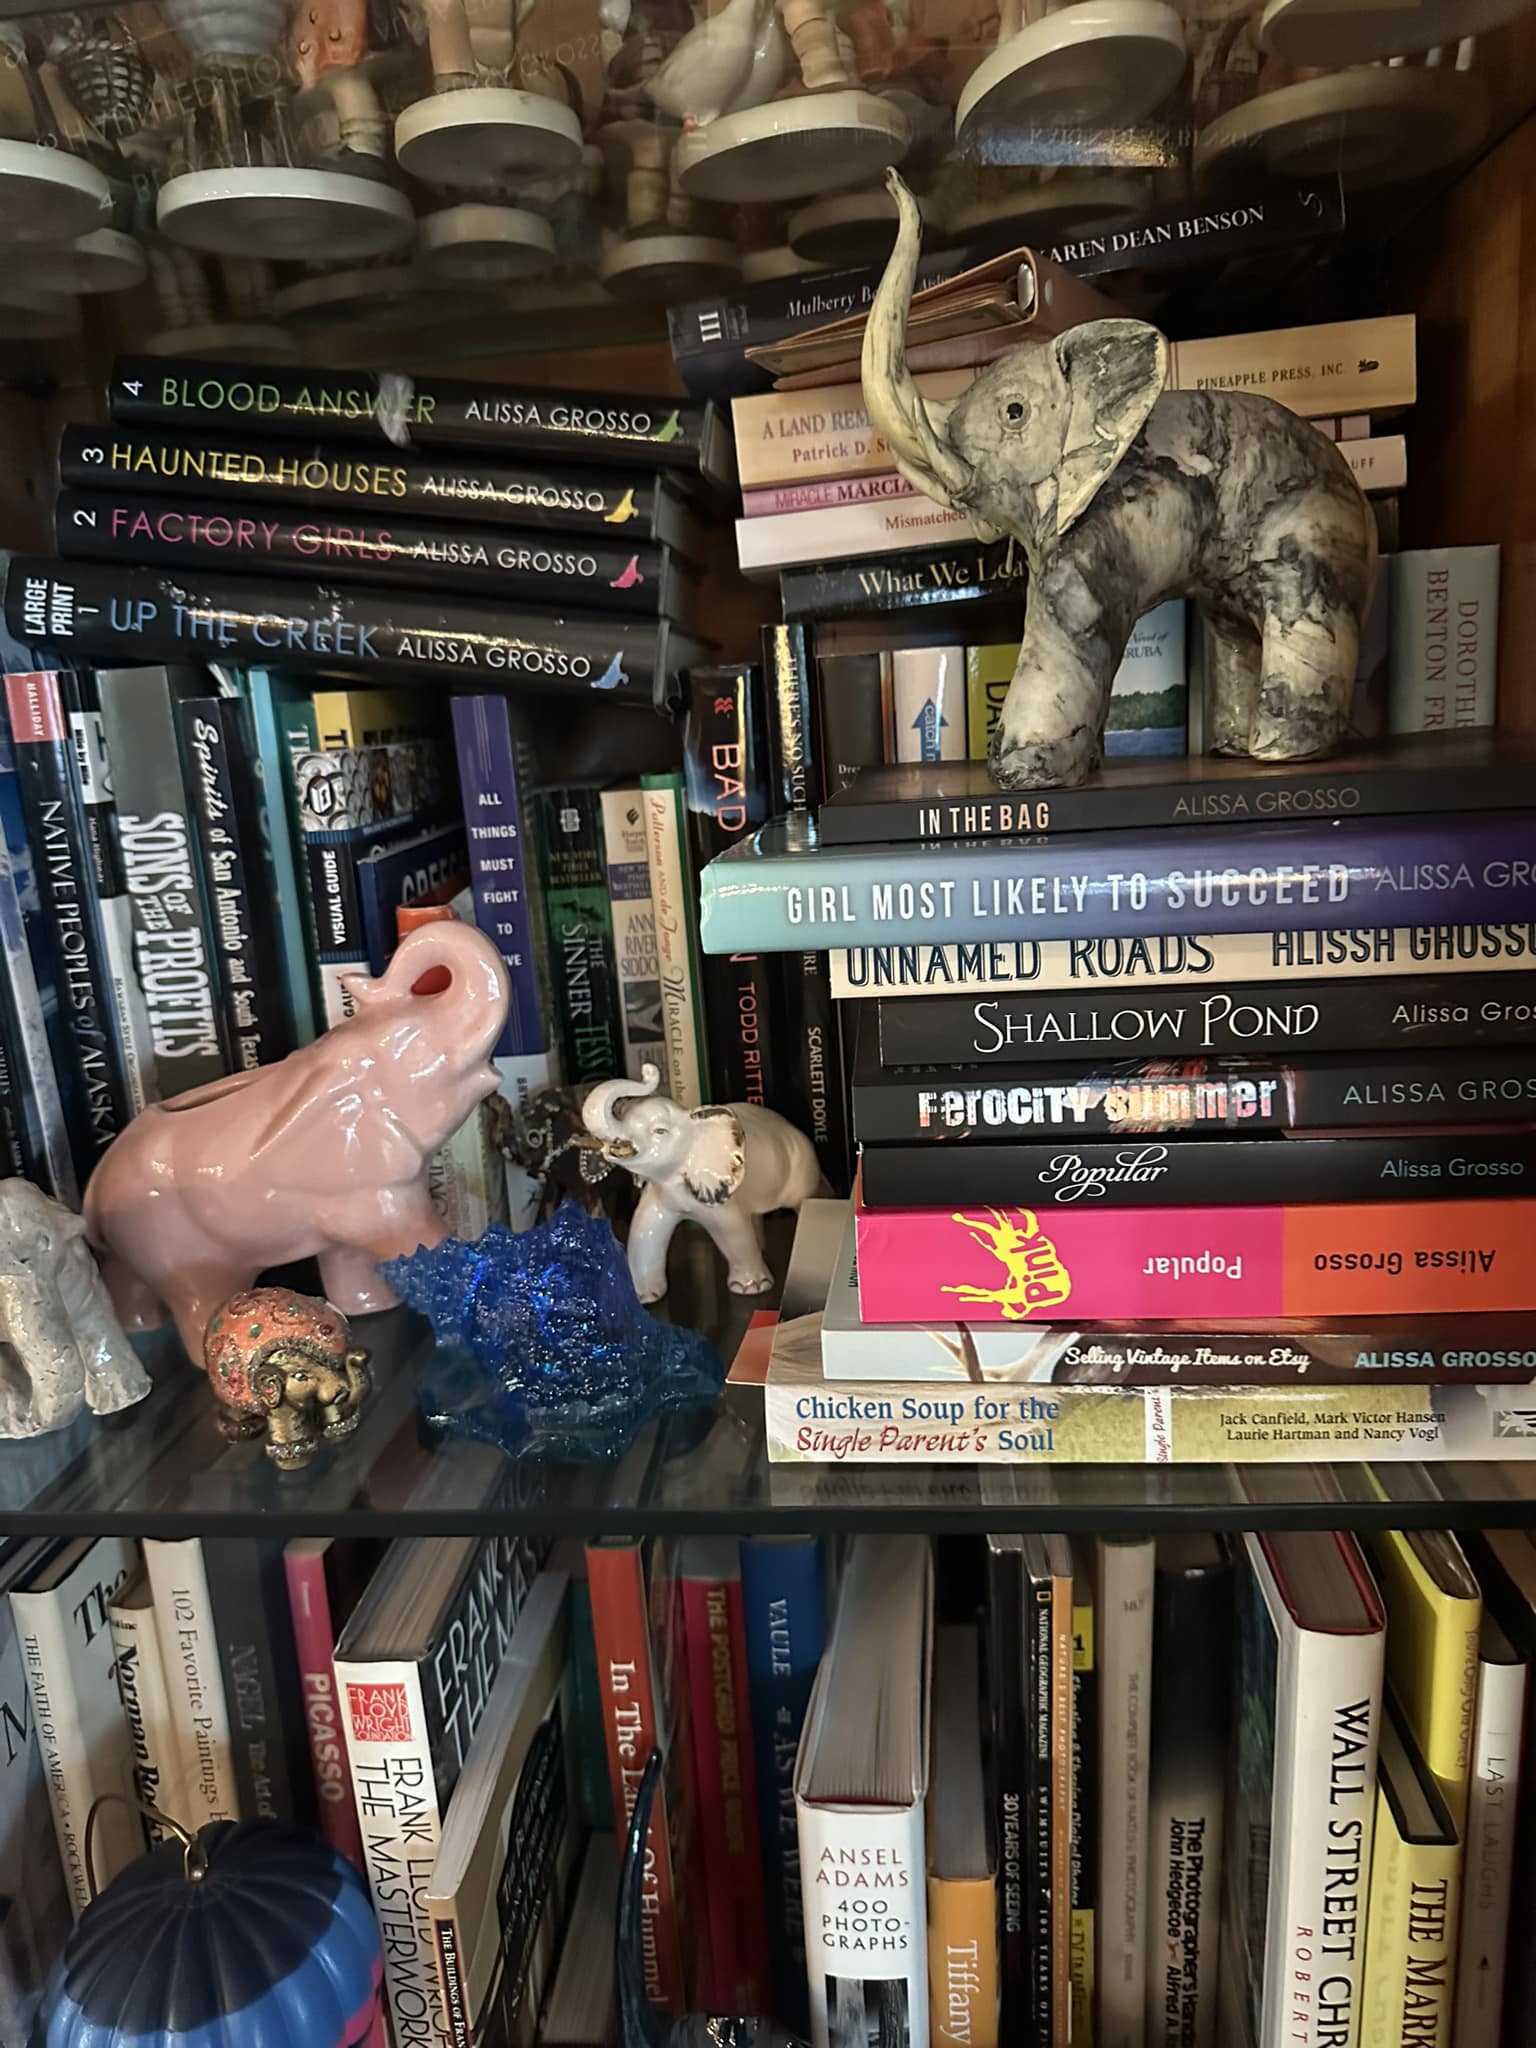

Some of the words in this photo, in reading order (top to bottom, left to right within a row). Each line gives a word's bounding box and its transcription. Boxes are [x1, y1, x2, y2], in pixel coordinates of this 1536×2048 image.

[1112, 225, 1172, 250] DEAN
[1178, 206, 1264, 239] BENSON
[786, 293, 856, 320] Mulberry
[123, 378, 143, 395] 4
[161, 378, 279, 412] BLOOD
[1197, 371, 1267, 390] PINEAPPLE
[1271, 367, 1312, 381] PRESS
[464, 400, 542, 426] ALISSA
[549, 407, 652, 434] GROSSO
[780, 415, 826, 438] LAND
[82, 447, 104, 463] 3
[110, 443, 266, 483] HAUNTED
[274, 459, 408, 497] HOUSES
[792, 444, 849, 463] Patrick
[855, 444, 871, 456] D.
[422, 475, 498, 500] ALISSA
[504, 484, 605, 513] GROSSO
[775, 487, 835, 509] MIRACLE
[74, 509, 98, 526] 2
[111, 510, 280, 552] FACTORY
[291, 525, 393, 561] GIRLS
[412, 541, 489, 567] ALISSA
[496, 548, 597, 577] GROSSO
[858, 568, 924, 596] What
[927, 559, 971, 587] We
[26, 577, 48, 637] LARGE
[53, 581, 75, 637] PRINT
[1425, 569, 1450, 683] BENTON
[109, 600, 157, 632] UP
[171, 606, 239, 646] THE
[250, 613, 381, 658] CREEK
[398, 636, 477, 665] ALISSA
[486, 648, 591, 679] GROSSO
[27, 682, 44, 737] HALLIDAY
[789, 729, 806, 761] NO
[194, 717, 230, 822] Spirits
[711, 743, 748, 833] BAD
[790, 764, 808, 812] SUCH
[478, 793, 502, 807] ALL
[920, 808, 941, 835] IN
[949, 804, 992, 832] THE
[999, 802, 1050, 831] BAG
[1173, 794, 1249, 818] ALISSA
[1255, 787, 1360, 813] GROSSO
[40, 800, 77, 897] NATIVE
[209, 827, 226, 849] of
[472, 825, 517, 840] THINGS
[118, 812, 194, 895] SONS
[209, 850, 238, 882] San
[321, 850, 341, 894] GUIDE
[480, 857, 515, 872] MUST
[483, 890, 519, 904] FIGHT
[787, 885, 856, 924] GIRL
[872, 881, 955, 922] MOST
[973, 875, 1089, 917] LIKELY
[1107, 873, 1148, 912] TO
[1167, 864, 1350, 909] SUCCEED
[1374, 864, 1475, 892] ALISSA
[135, 894, 173, 931] THE
[164, 893, 194, 915] OF
[215, 886, 250, 953] Antonio
[326, 894, 347, 945] VISUAL
[496, 923, 513, 935] TO
[1272, 928, 1396, 967] ALISSA
[55, 901, 97, 1011] PEOPLES
[228, 956, 253, 984] and
[561, 923, 593, 1020] SINNER
[590, 939, 608, 970] THE
[846, 941, 1042, 987] UNNAMED
[1069, 935, 1215, 978] ROADS
[136, 927, 221, 1059] PROFITS
[81, 1013, 106, 1043] of
[738, 982, 760, 1044] TODD
[973, 1001, 1187, 1054] SHALLOW
[1199, 994, 1320, 1047] POND
[1392, 1004, 1470, 1026] Alissa
[808, 1026, 825, 1094] SCARLETT
[81, 1045, 118, 1146] ALASKA
[1343, 1083, 1446, 1105] ALISSA
[812, 1098, 829, 1144] DOYLE
[1038, 1145, 1169, 1202] Popular
[1380, 1159, 1442, 1178] Alissa
[1448, 1158, 1525, 1178] Grosso
[1143, 1250, 1242, 1280] Popular
[1314, 1252, 1403, 1276] Grosso
[1415, 1250, 1497, 1276] Alissa
[1064, 1346, 1125, 1373] Selling
[1126, 1347, 1190, 1373] Vintage
[1193, 1347, 1242, 1368] Items
[1244, 1352, 1267, 1367] on
[1268, 1347, 1311, 1373] Etsy
[1355, 1351, 1436, 1369] ALISSA
[1442, 1350, 1536, 1368] GROSSO
[796, 1397, 894, 1421] Chicken
[902, 1397, 966, 1426] Soup
[973, 1396, 1011, 1421] for
[1019, 1395, 1061, 1421] the
[1220, 1412, 1248, 1427] Jack
[1251, 1411, 1311, 1427] Canfield,
[1313, 1411, 1349, 1426] Mark
[1352, 1411, 1395, 1425] Victor
[1396, 1410, 1447, 1425] Hansen
[796, 1425, 872, 1460] Single
[879, 1425, 988, 1453] Parent's
[998, 1428, 1056, 1452] Soul
[1226, 1428, 1270, 1441] Laurie
[1273, 1428, 1331, 1441] Hartman
[1334, 1427, 1360, 1440] and
[1363, 1427, 1407, 1444] Nancy
[1408, 1426, 1441, 1443] Vogl
[172, 1589, 196, 1622] 102
[768, 1598, 793, 1678] VAULE
[1038, 1608, 1049, 1654] NATIONAL
[24, 1634, 42, 1667] THE
[178, 1628, 209, 1710] Favorite
[31, 1670, 52, 1719] FAITH
[346, 1686, 406, 1704] FRANK
[609, 1659, 636, 1694] In
[1038, 1656, 1049, 1712] GEOGRAPHIC
[41, 1723, 57, 1746] OF
[304, 1672, 345, 1801] PICASSO
[352, 1714, 411, 1732] WRIGHT
[614, 1701, 643, 1759] The
[1038, 1713, 1049, 1760] MAGAZINE
[192, 1716, 218, 1805] Paintings
[1332, 1697, 1371, 1807] WALL
[355, 1757, 397, 1819] THE
[388, 1757, 435, 1845] FRANK
[1487, 1756, 1505, 1808] LAST
[1003, 1793, 1020, 1811] 30
[1004, 1811, 1021, 1865] YEARS
[1169, 1817, 1187, 1856] John
[1187, 1816, 1206, 1853] The
[820, 1847, 904, 1866] ANSEL
[815, 1869, 909, 1888] ADAMS
[1321, 1820, 1363, 1963] STREET
[837, 1899, 889, 1915] 400
[1004, 1883, 1021, 1934] SEEING
[1165, 1859, 1186, 1939] Hedgecoe
[1409, 1879, 1449, 1944] THE
[441, 1927, 454, 1951] THE
[821, 1915, 911, 1932] PHOTO-
[822, 1935, 909, 1951] GRAPHS
[938, 1938, 978, 2047] Tiffany
[1165, 1965, 1183, 2016] Alfred
[1291, 1925, 1314, 2044] ROBERT
